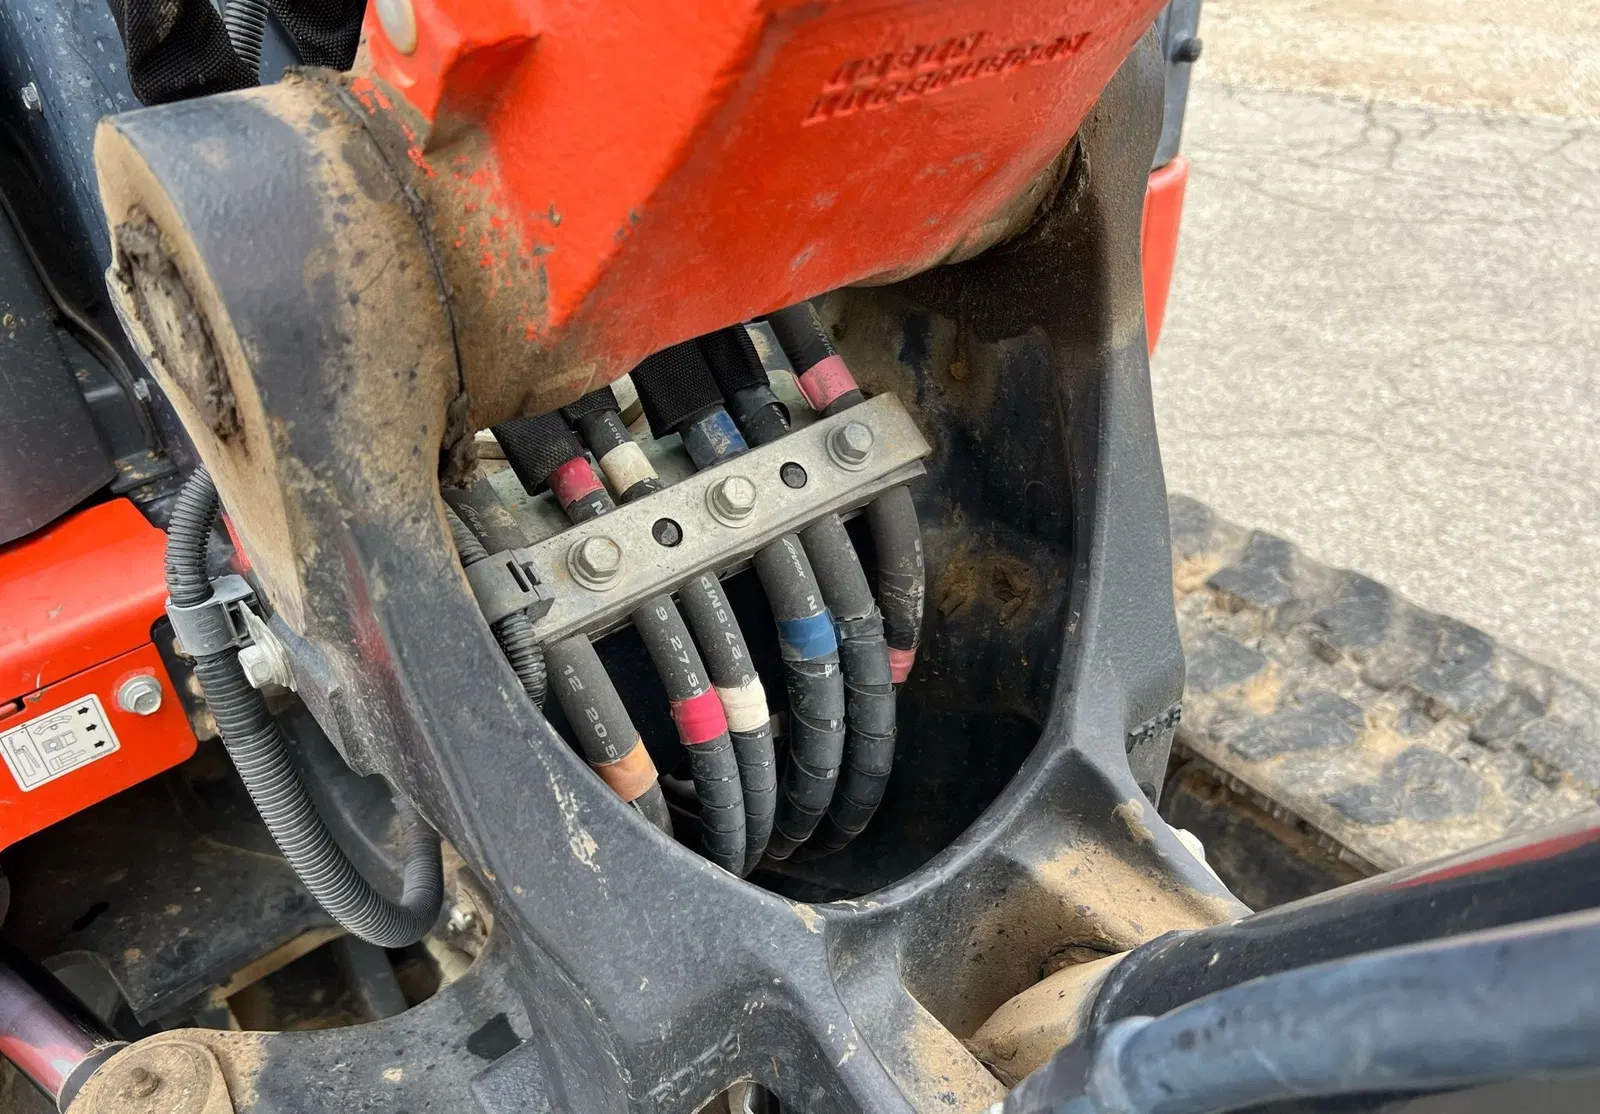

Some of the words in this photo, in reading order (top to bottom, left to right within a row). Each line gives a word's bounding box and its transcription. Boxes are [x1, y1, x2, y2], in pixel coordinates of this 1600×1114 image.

[655, 606, 668, 621] 9
[563, 664, 584, 692] 12
[585, 706, 620, 762] 20.5
